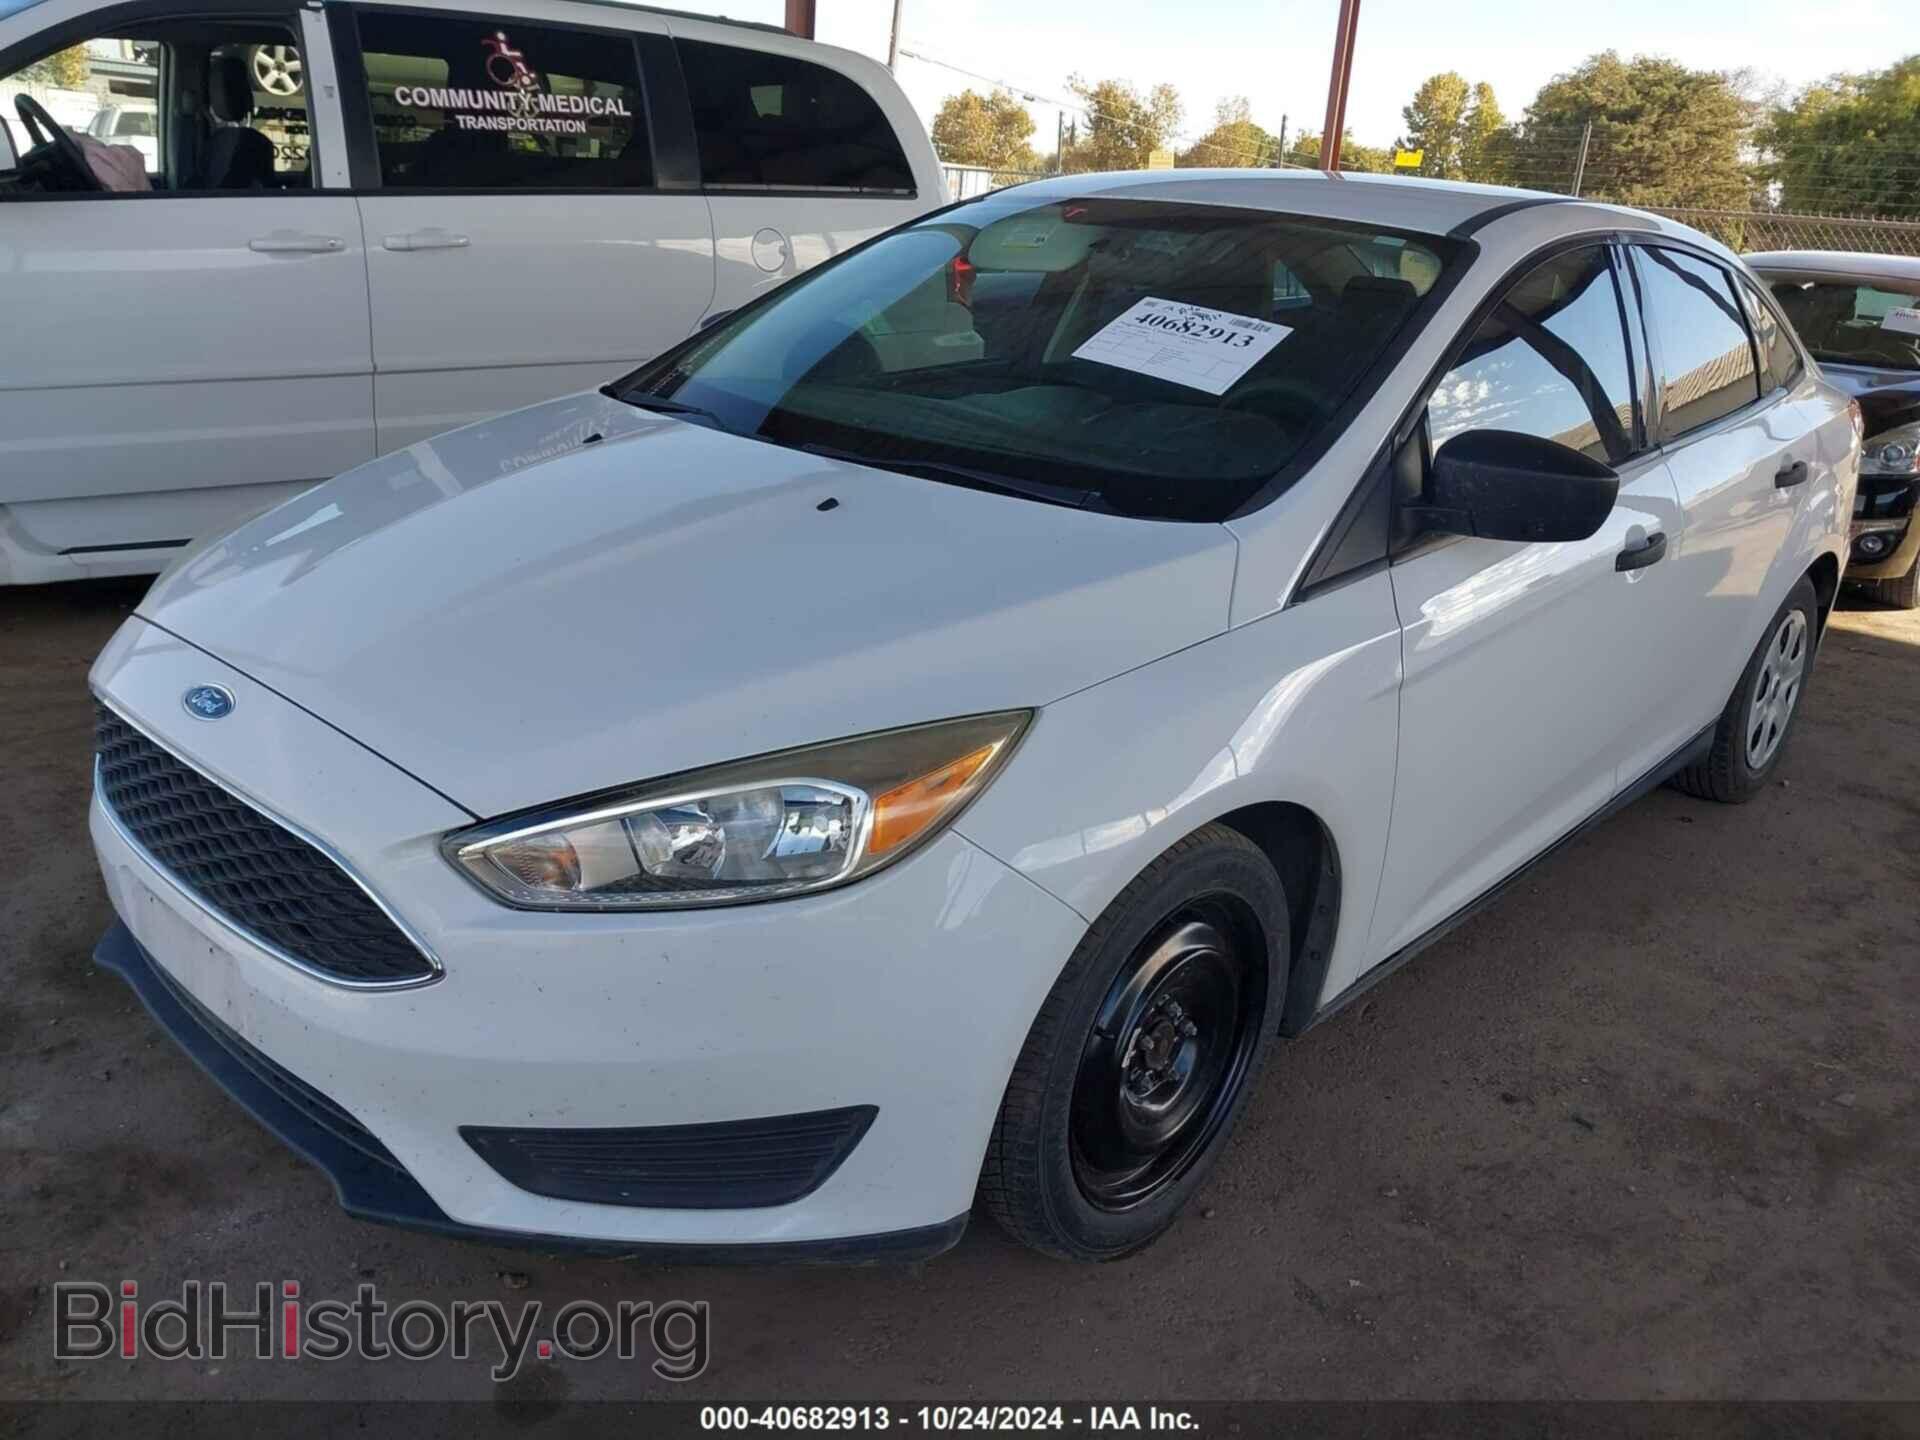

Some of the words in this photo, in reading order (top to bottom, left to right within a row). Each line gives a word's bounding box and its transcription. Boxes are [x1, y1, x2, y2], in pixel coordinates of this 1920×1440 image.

[394, 86, 533, 112] COMMUNITY
[538, 94, 632, 116] MEDICAL
[455, 114, 587, 133] TRANSPORTATION
[1135, 313, 1255, 347] 40682913
